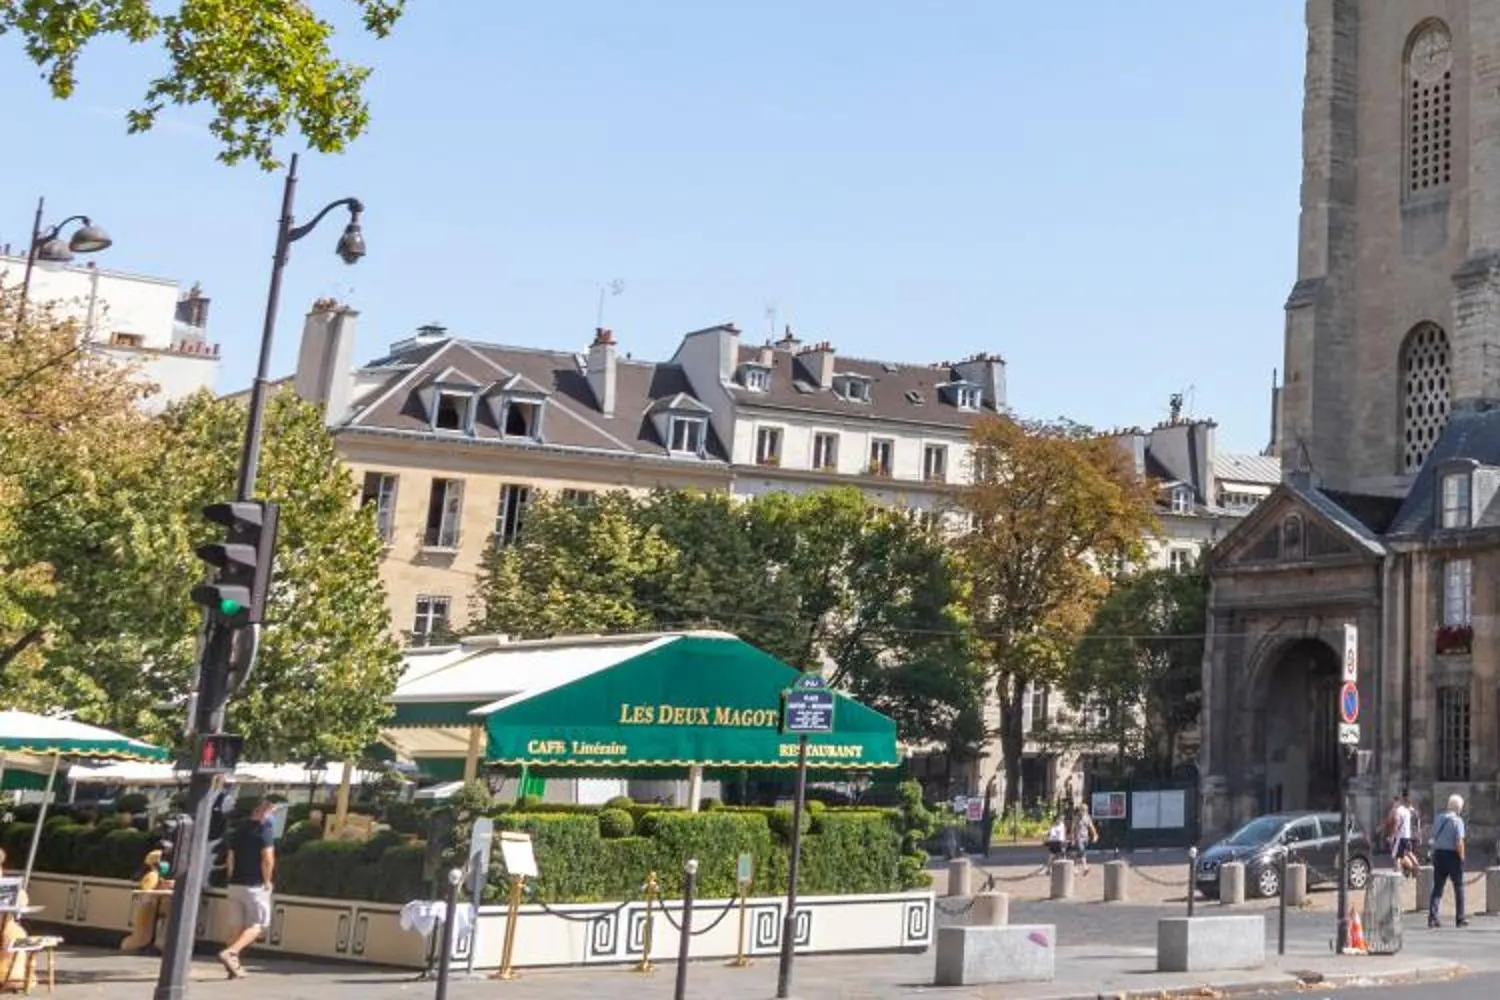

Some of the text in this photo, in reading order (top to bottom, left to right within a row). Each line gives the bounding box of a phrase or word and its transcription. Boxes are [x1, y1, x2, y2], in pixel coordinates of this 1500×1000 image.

[620, 703, 654, 724] LES
[657, 704, 709, 725] DEUX
[713, 706, 780, 727] MAGOT
